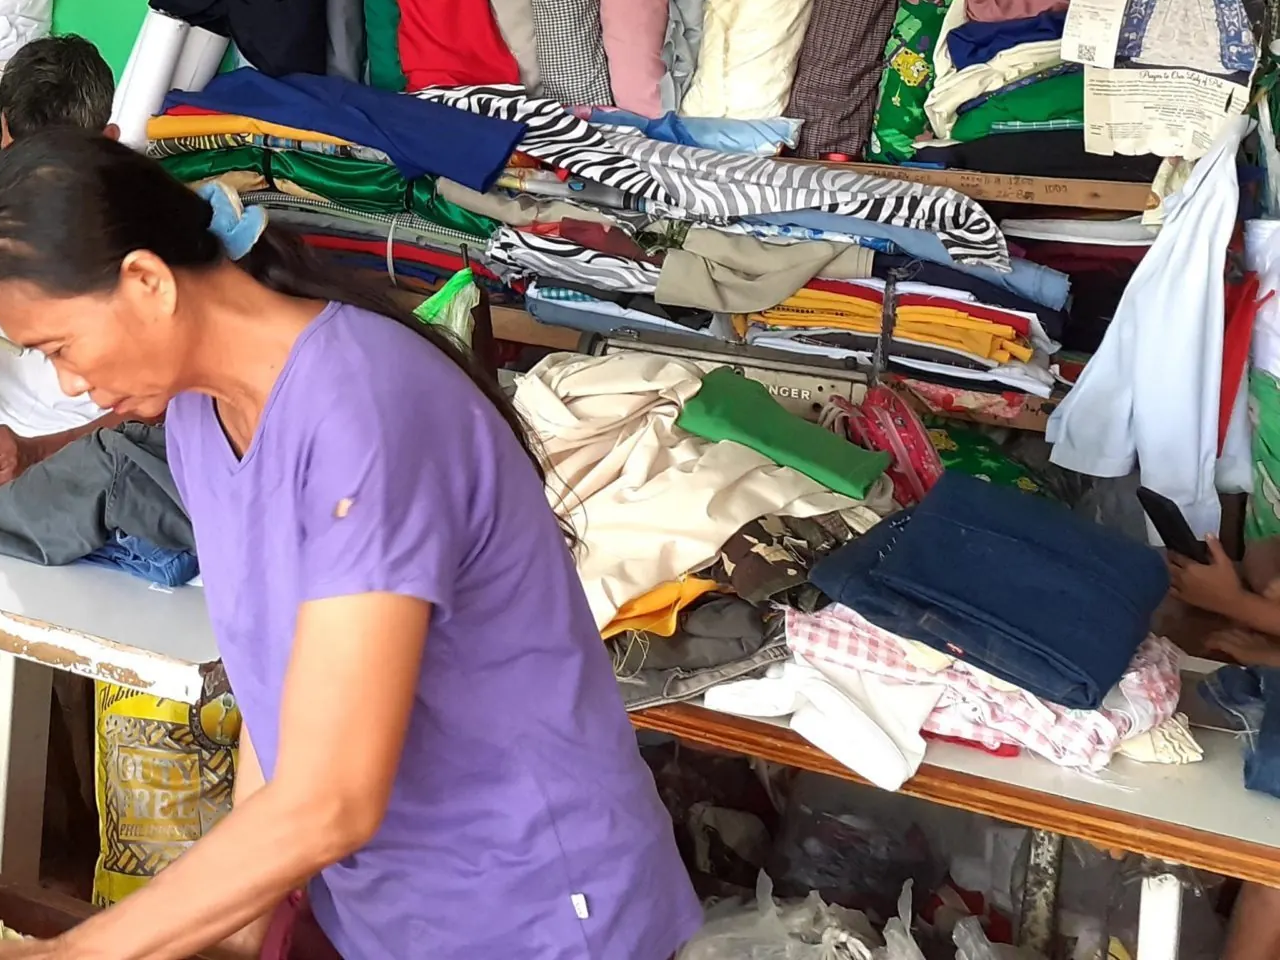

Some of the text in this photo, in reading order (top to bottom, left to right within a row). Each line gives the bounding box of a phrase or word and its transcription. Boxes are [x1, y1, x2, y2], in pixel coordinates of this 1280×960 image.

[769, 384, 810, 400] NGER
[118, 752, 198, 786] DUTY
[117, 787, 198, 819] FREE
